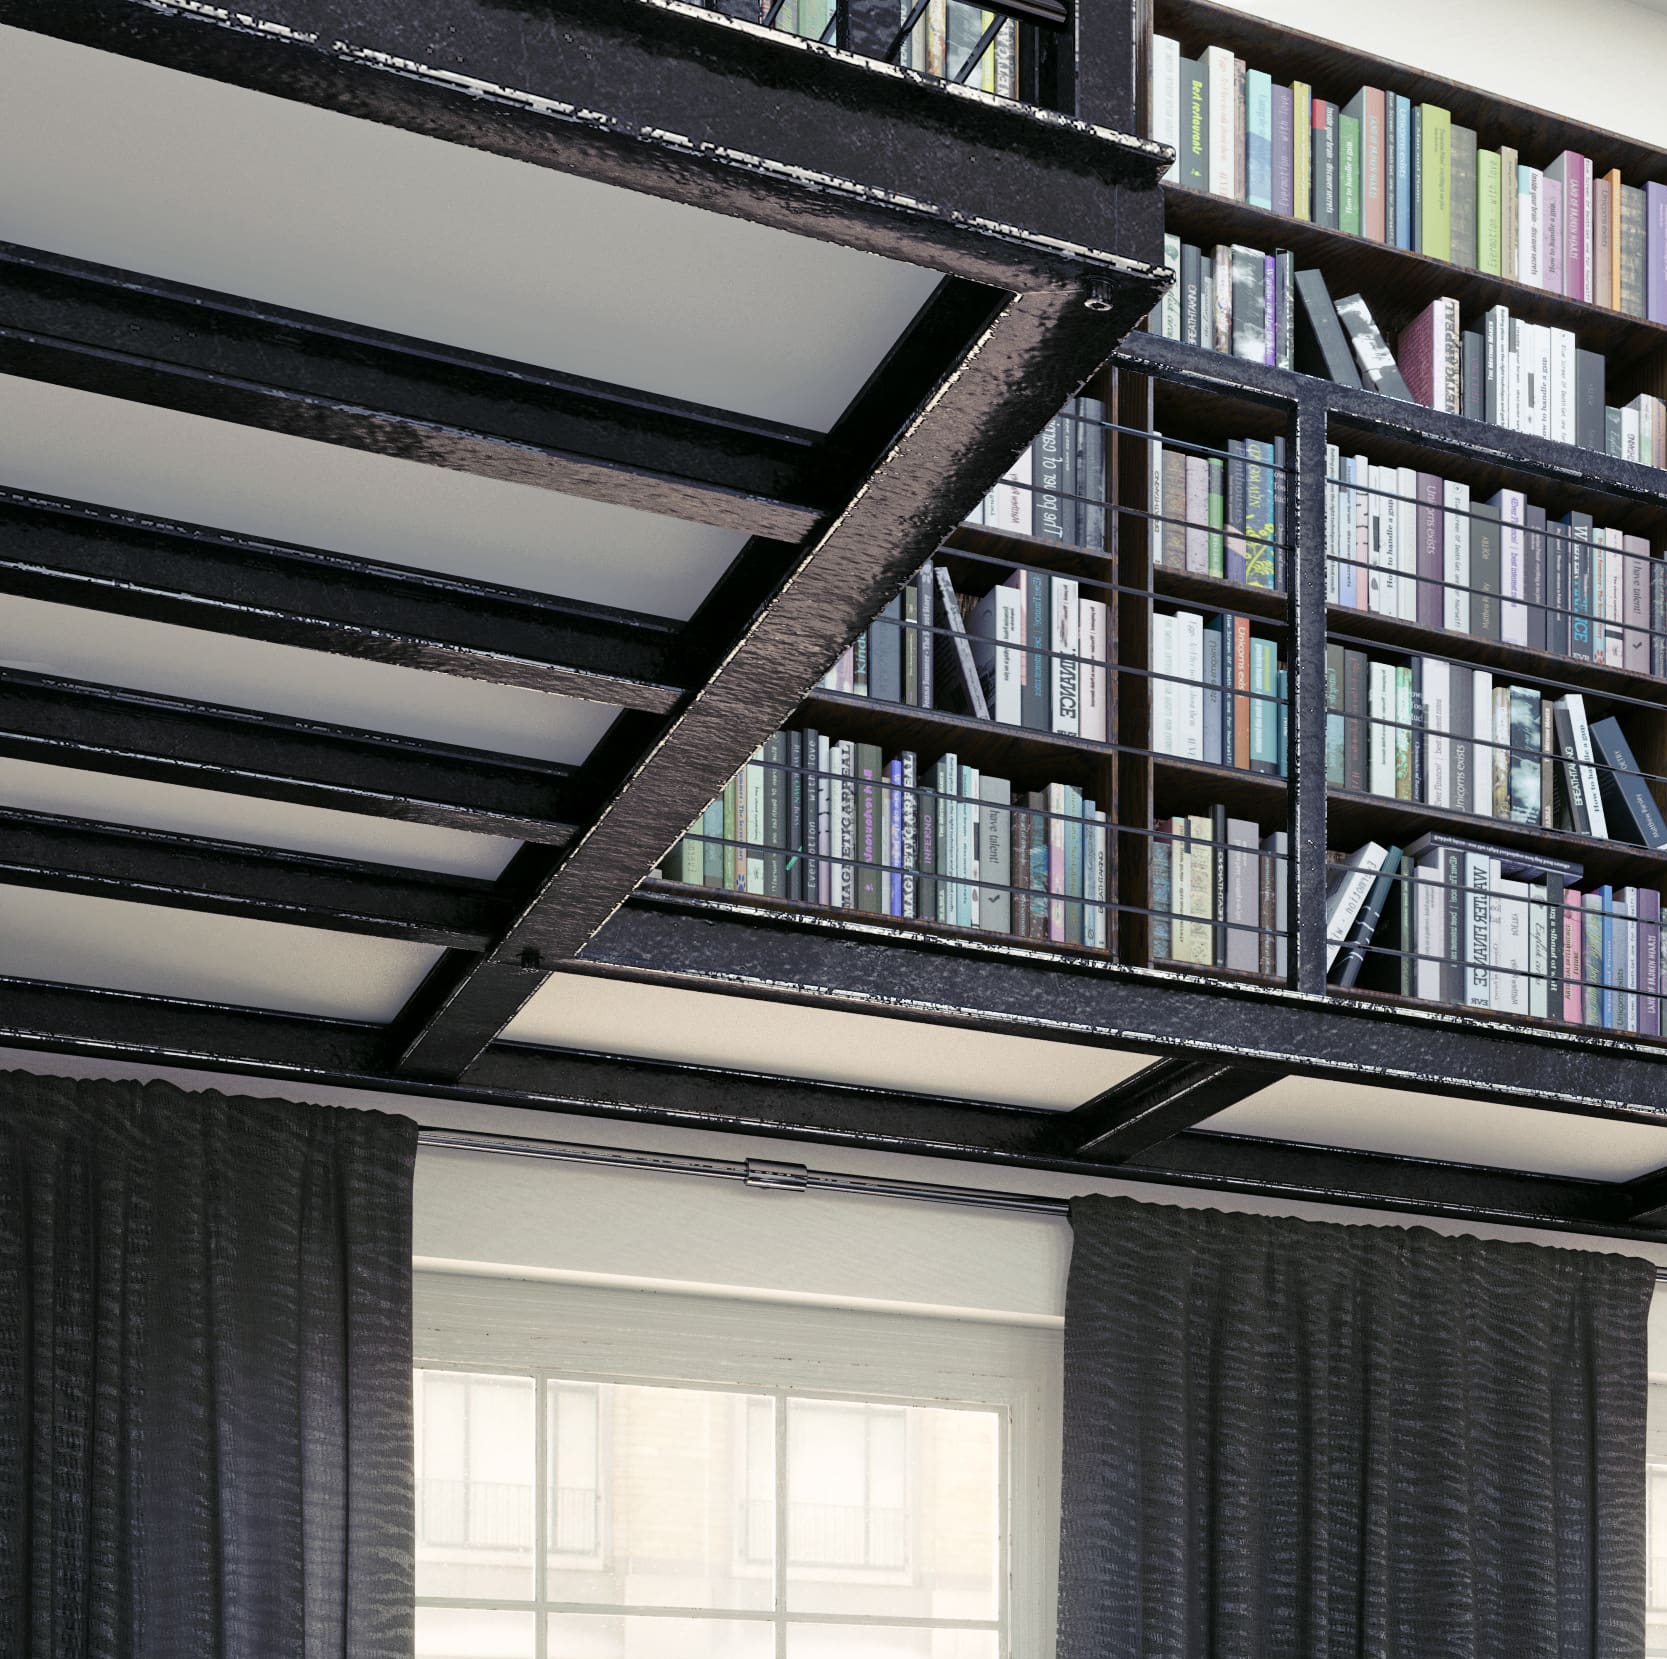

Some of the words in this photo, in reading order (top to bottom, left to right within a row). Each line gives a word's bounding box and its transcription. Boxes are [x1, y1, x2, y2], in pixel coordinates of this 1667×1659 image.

[1191, 80, 1203, 100] Best
[1191, 101, 1203, 155] restaurants
[1325, 107, 1335, 124] Inside
[1324, 124, 1334, 142] your
[1326, 142, 1335, 159] brain
[1326, 162, 1335, 189] discover
[1326, 190, 1335, 214] secrets
[1345, 198, 1354, 214] How
[1187, 284, 1196, 346] REATHTAKING
[1238, 626, 1247, 670] Unicorns
[1238, 671, 1247, 698] exiss
[1455, 744, 1465, 770] exists
[924, 814, 932, 864] INFERNO
